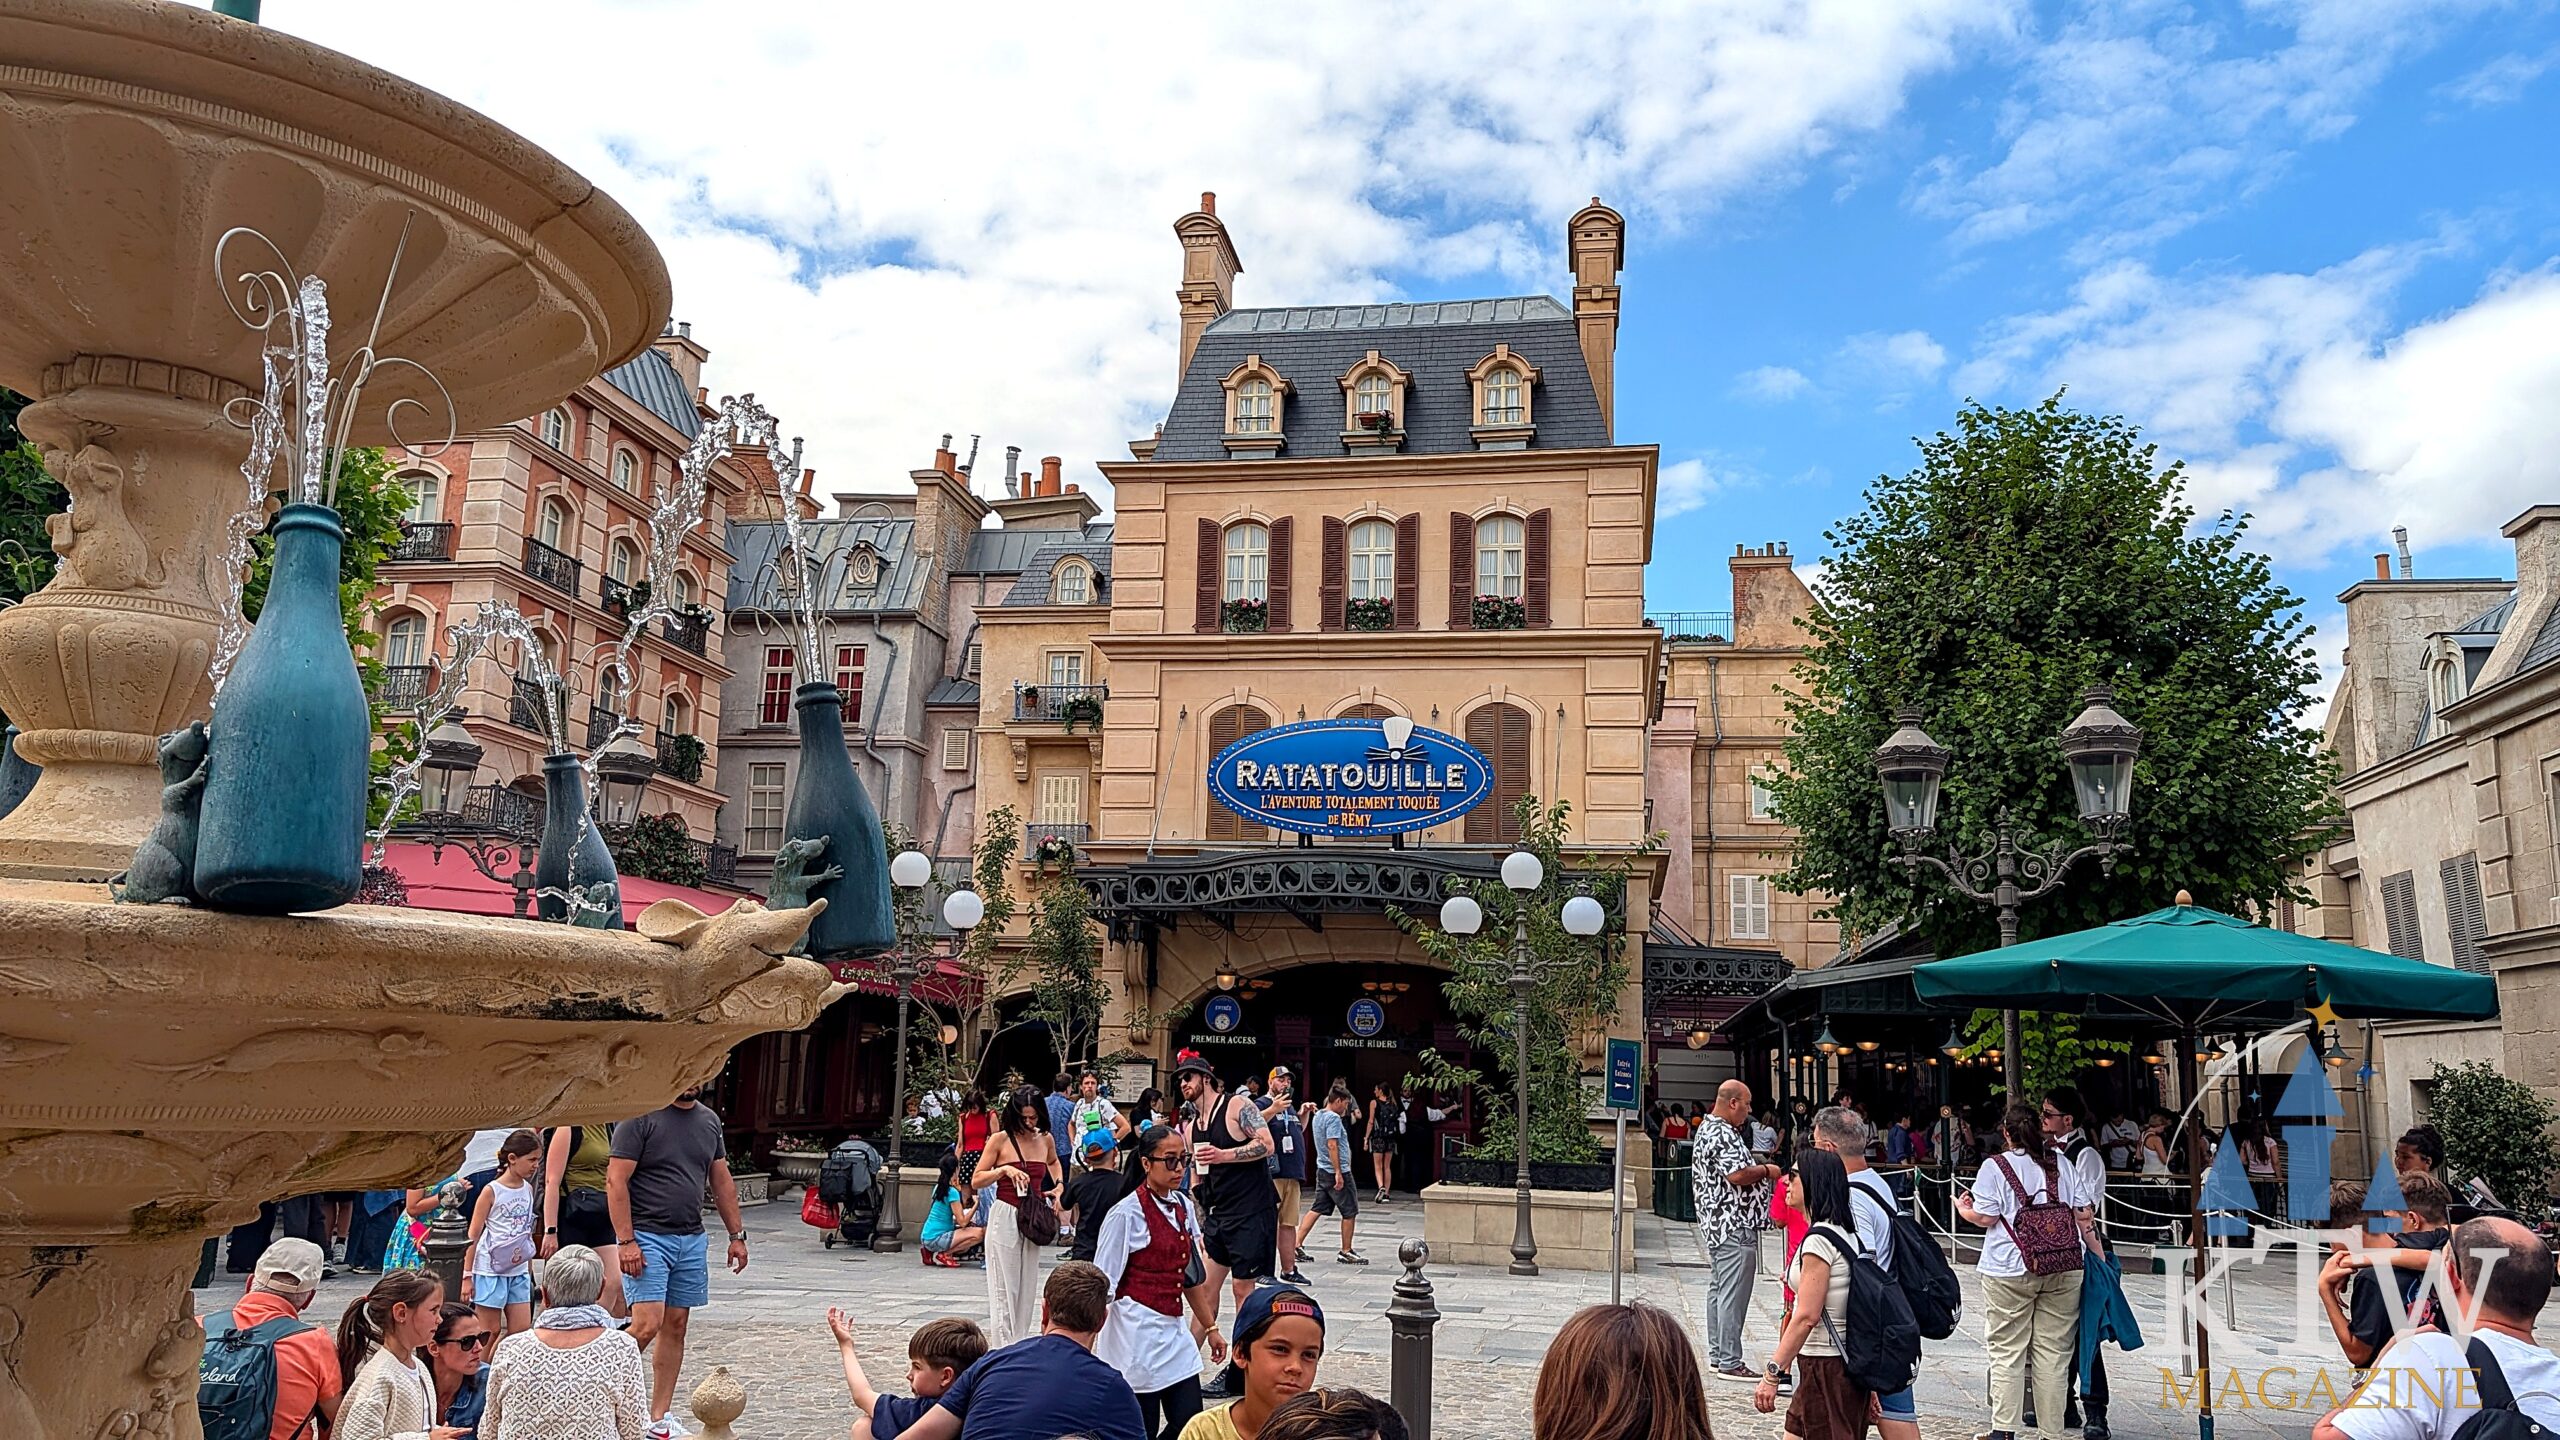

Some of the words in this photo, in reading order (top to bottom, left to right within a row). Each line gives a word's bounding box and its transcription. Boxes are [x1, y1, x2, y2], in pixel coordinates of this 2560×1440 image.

[1237, 760, 1466, 791] RATATOUILLE
[1261, 794, 1322, 810] L'AVENTURE
[1325, 795, 1394, 811] TOTALEMENT
[1398, 792, 1440, 811] TOQUÉE
[1328, 815, 1339, 826] DE
[1341, 809, 1372, 828] RÉMY
[1190, 1034, 1226, 1044] PREMIER
[1227, 1035, 1257, 1045] ACCESS
[1333, 1038, 1365, 1048] SINGLE
[1367, 1039, 1397, 1049] RIDERS
